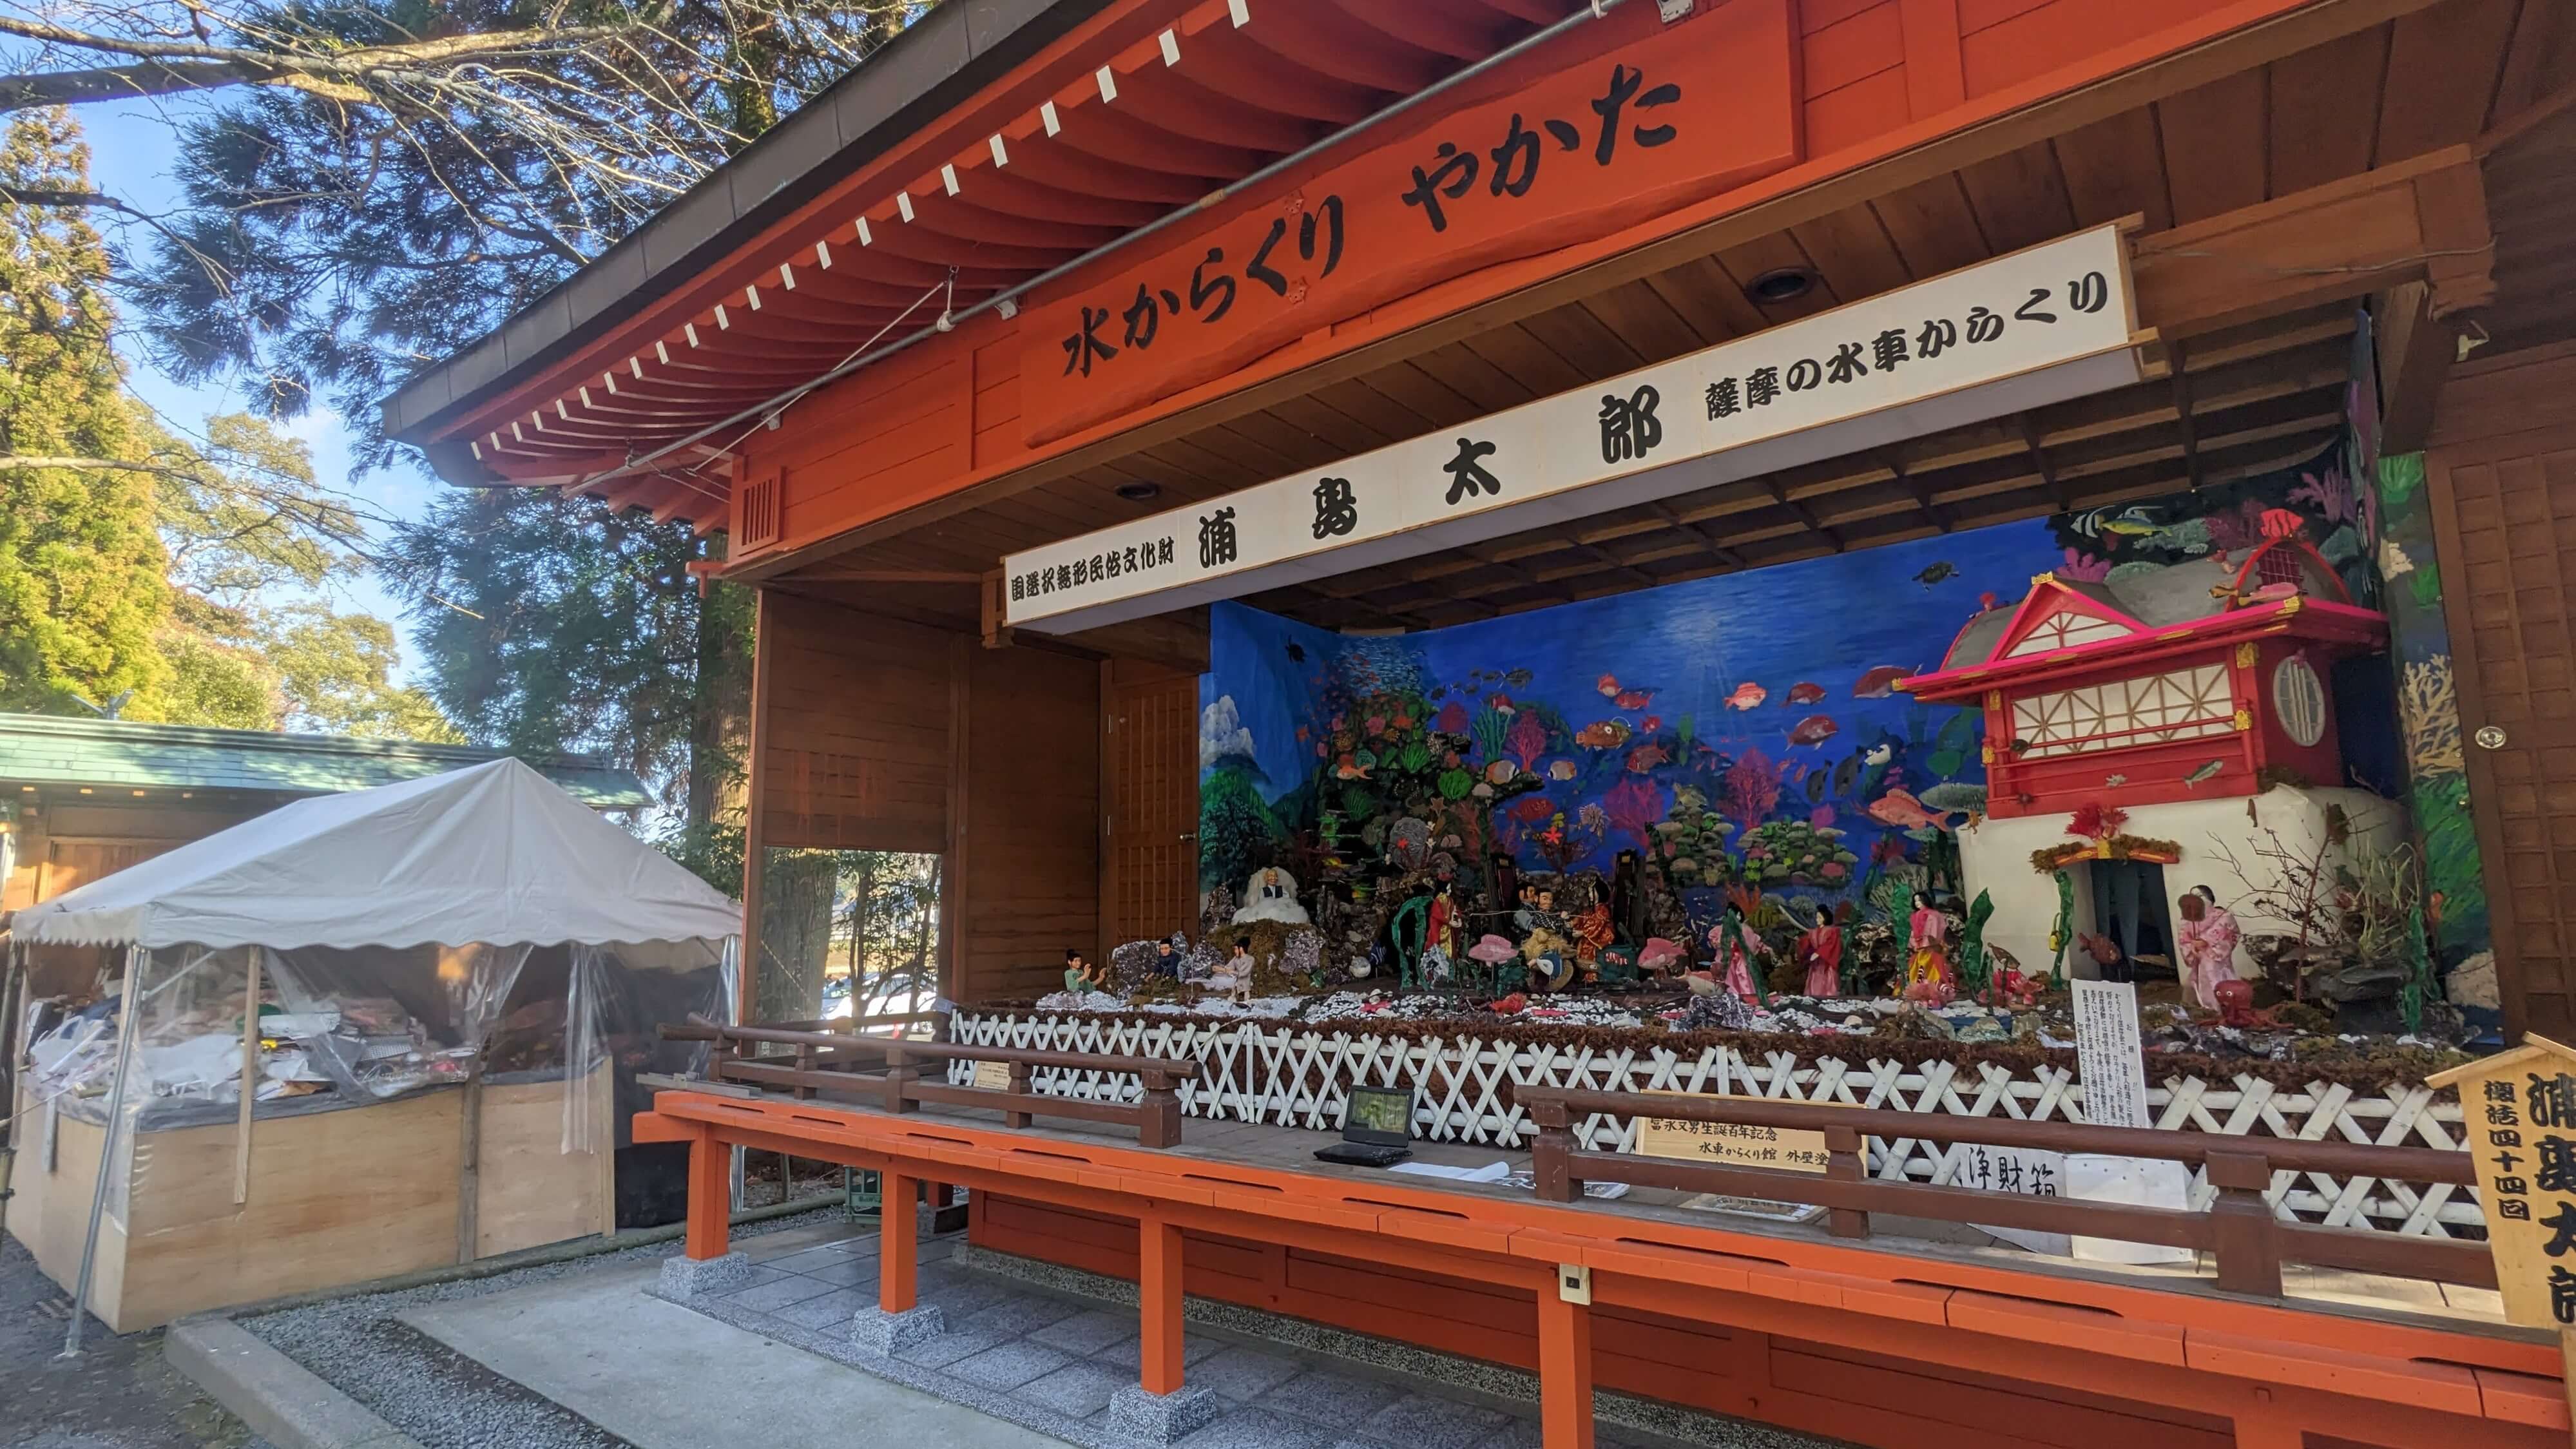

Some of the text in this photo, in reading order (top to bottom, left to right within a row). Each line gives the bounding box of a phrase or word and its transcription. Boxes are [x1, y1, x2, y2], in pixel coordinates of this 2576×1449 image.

[1062, 63, 1681, 378] 水からくり やかた
[1705, 271, 2108, 421] 薩摩の水車からくり
[1698, 1141, 1778, 1160] 水車からくり館
